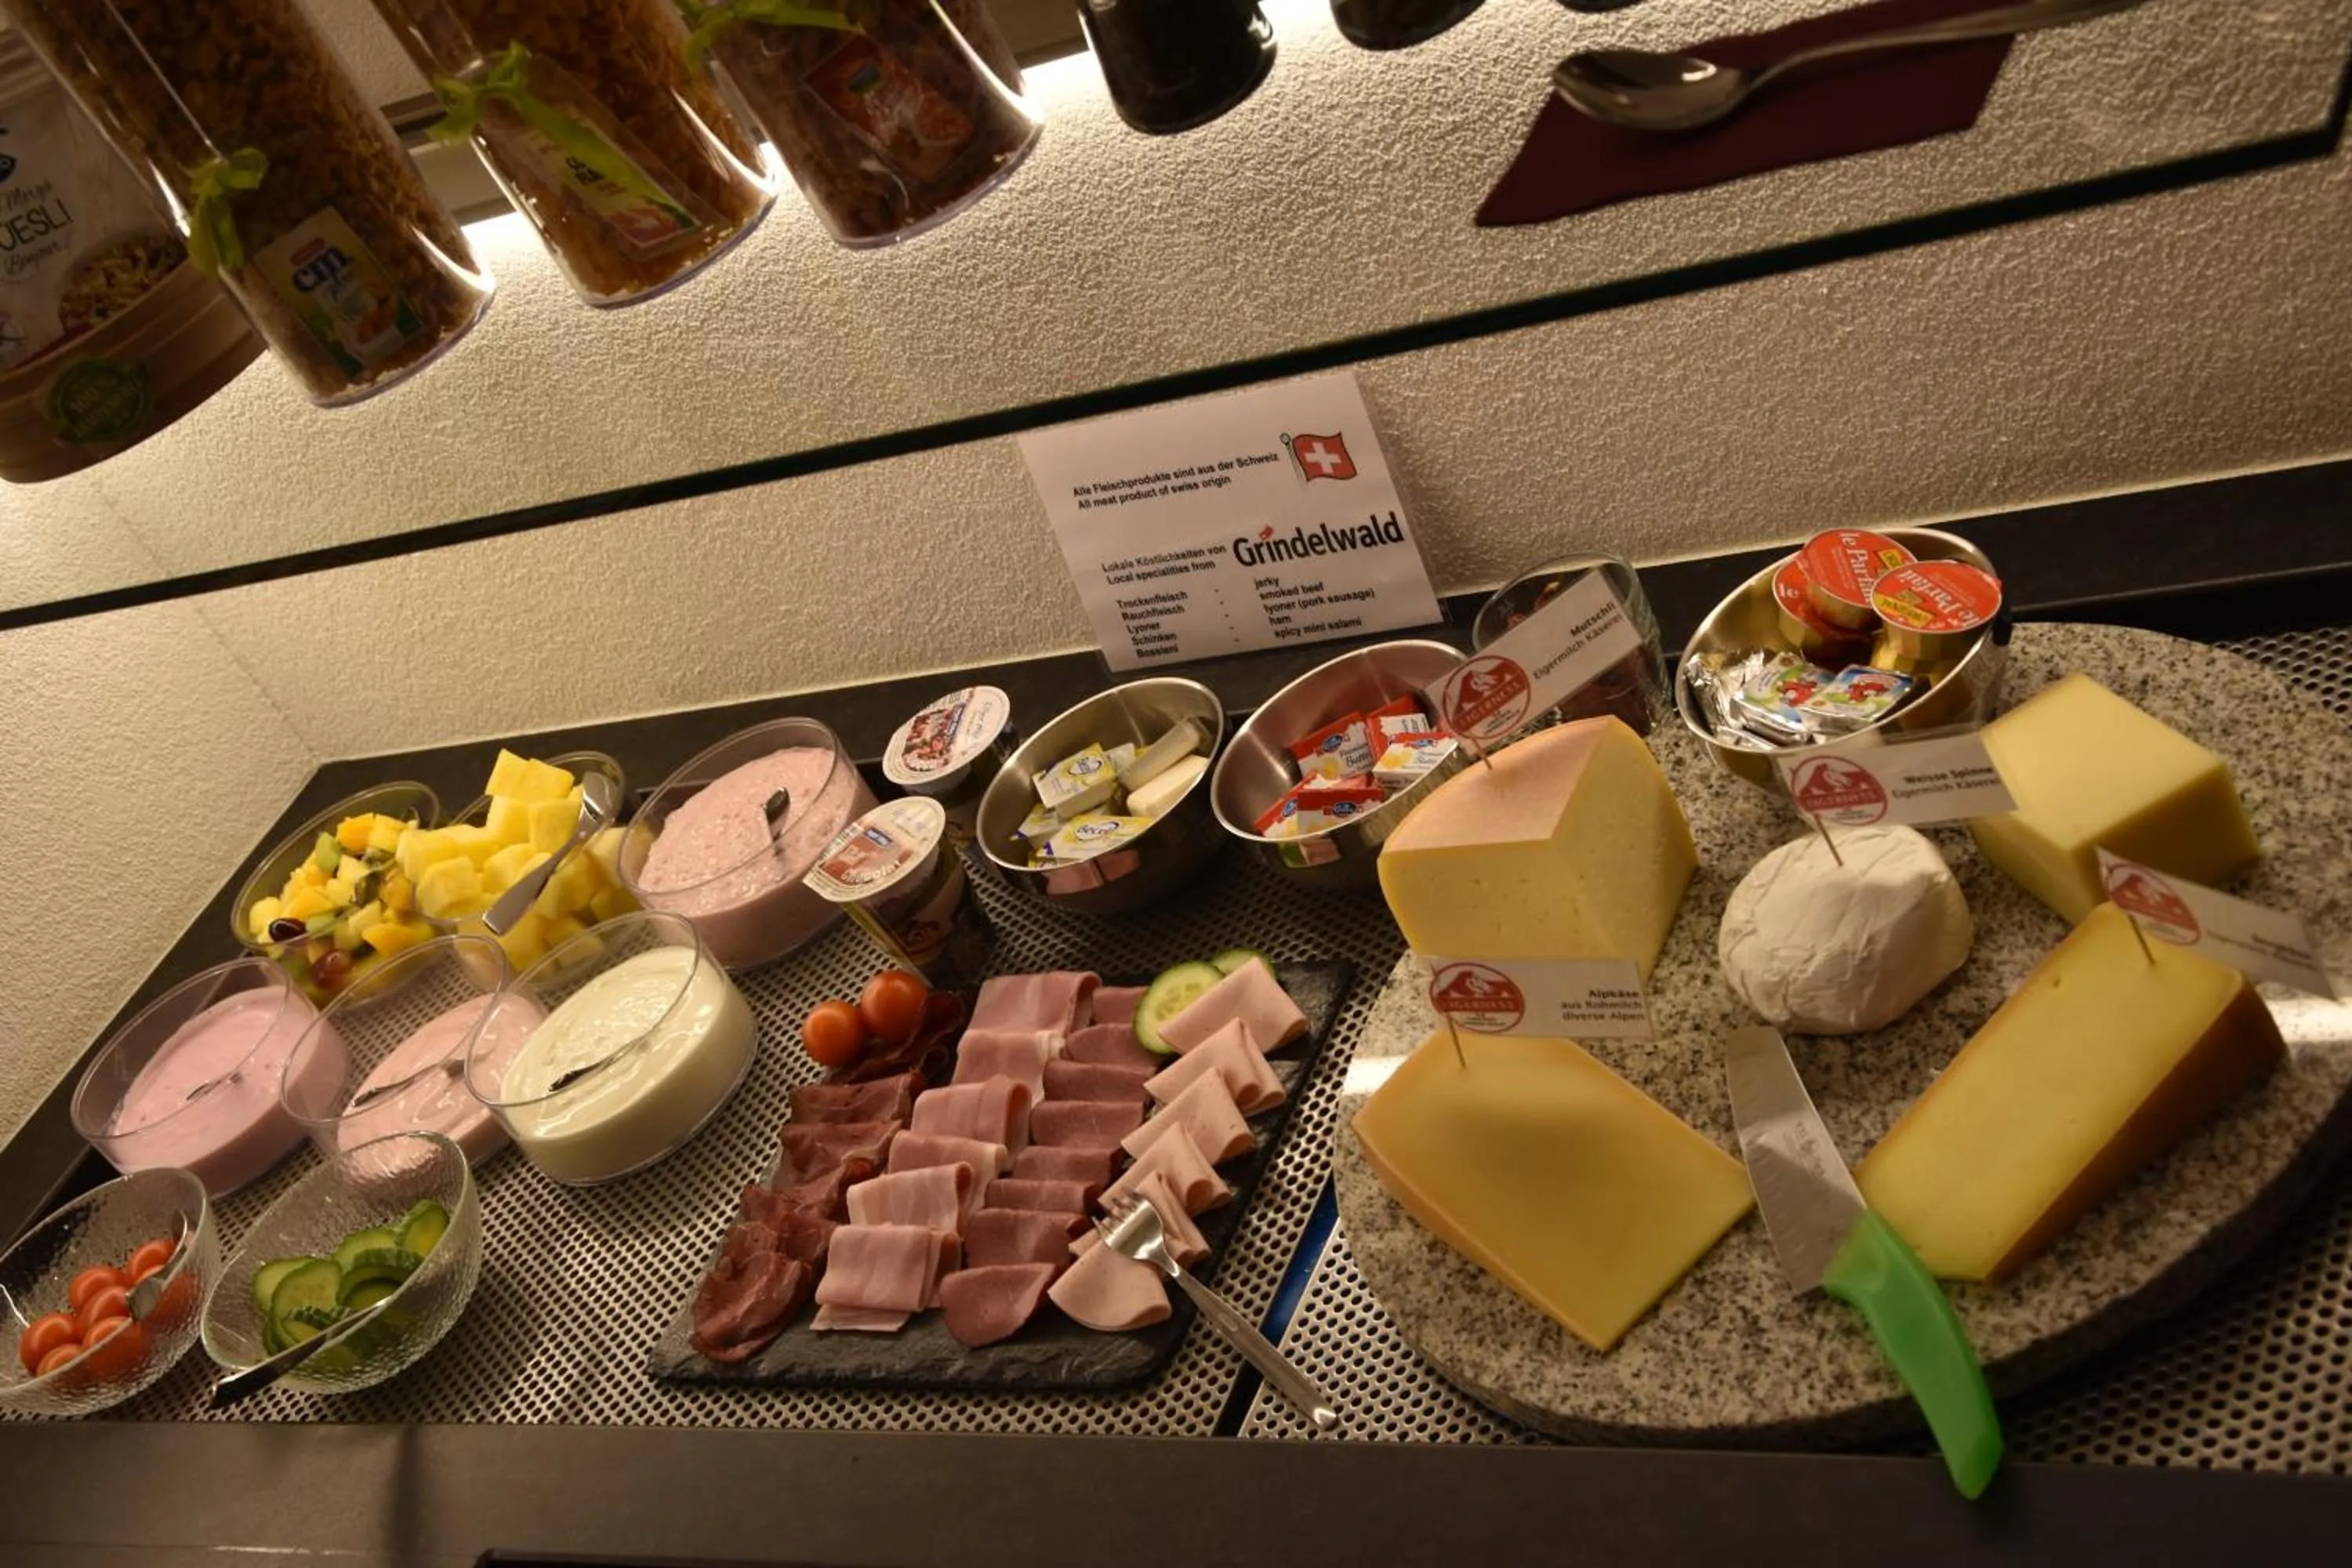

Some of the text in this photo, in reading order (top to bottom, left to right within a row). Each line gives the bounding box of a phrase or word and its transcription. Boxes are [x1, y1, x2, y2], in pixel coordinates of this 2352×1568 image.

[1073, 452, 1279, 498] Alle Fleischprodukte sind aus der Schweiz
[1078, 475, 1232, 510] All meat product of swiss origin
[1232, 511, 1406, 567] Grindelwald
[1838, 532, 1860, 547] le
[1102, 559, 1134, 573] Lokale
[1207, 545, 1227, 555] von
[1106, 573, 1134, 586] Local
[1191, 560, 1217, 572] from
[1846, 548, 1876, 604] Parfai
[1254, 577, 1279, 590] jerky
[1259, 581, 1324, 601] smoked beef
[1897, 569, 1962, 615] Parfait
[1116, 590, 1189, 608] Trockenfleisch
[1263, 588, 1375, 615] lyoner (pork sausage)
[1121, 604, 1185, 622] Rauchfleisch
[1269, 615, 1292, 626] ham
[1570, 601, 1617, 637] Mutschli
[1958, 608, 1981, 628] le
[1127, 622, 1160, 635] Lyoner
[1274, 616, 1363, 640] spicy mini salami
[1131, 632, 1178, 646] Schinken
[1533, 639, 1585, 681] Eigermilch
[1904, 766, 1994, 783] Weisse Spinne
[1588, 989, 1639, 1000] Alpkäse
[1584, 1000, 1643, 1010] Rohmilch
[1562, 1011, 1645, 1022] diverse Alpen
